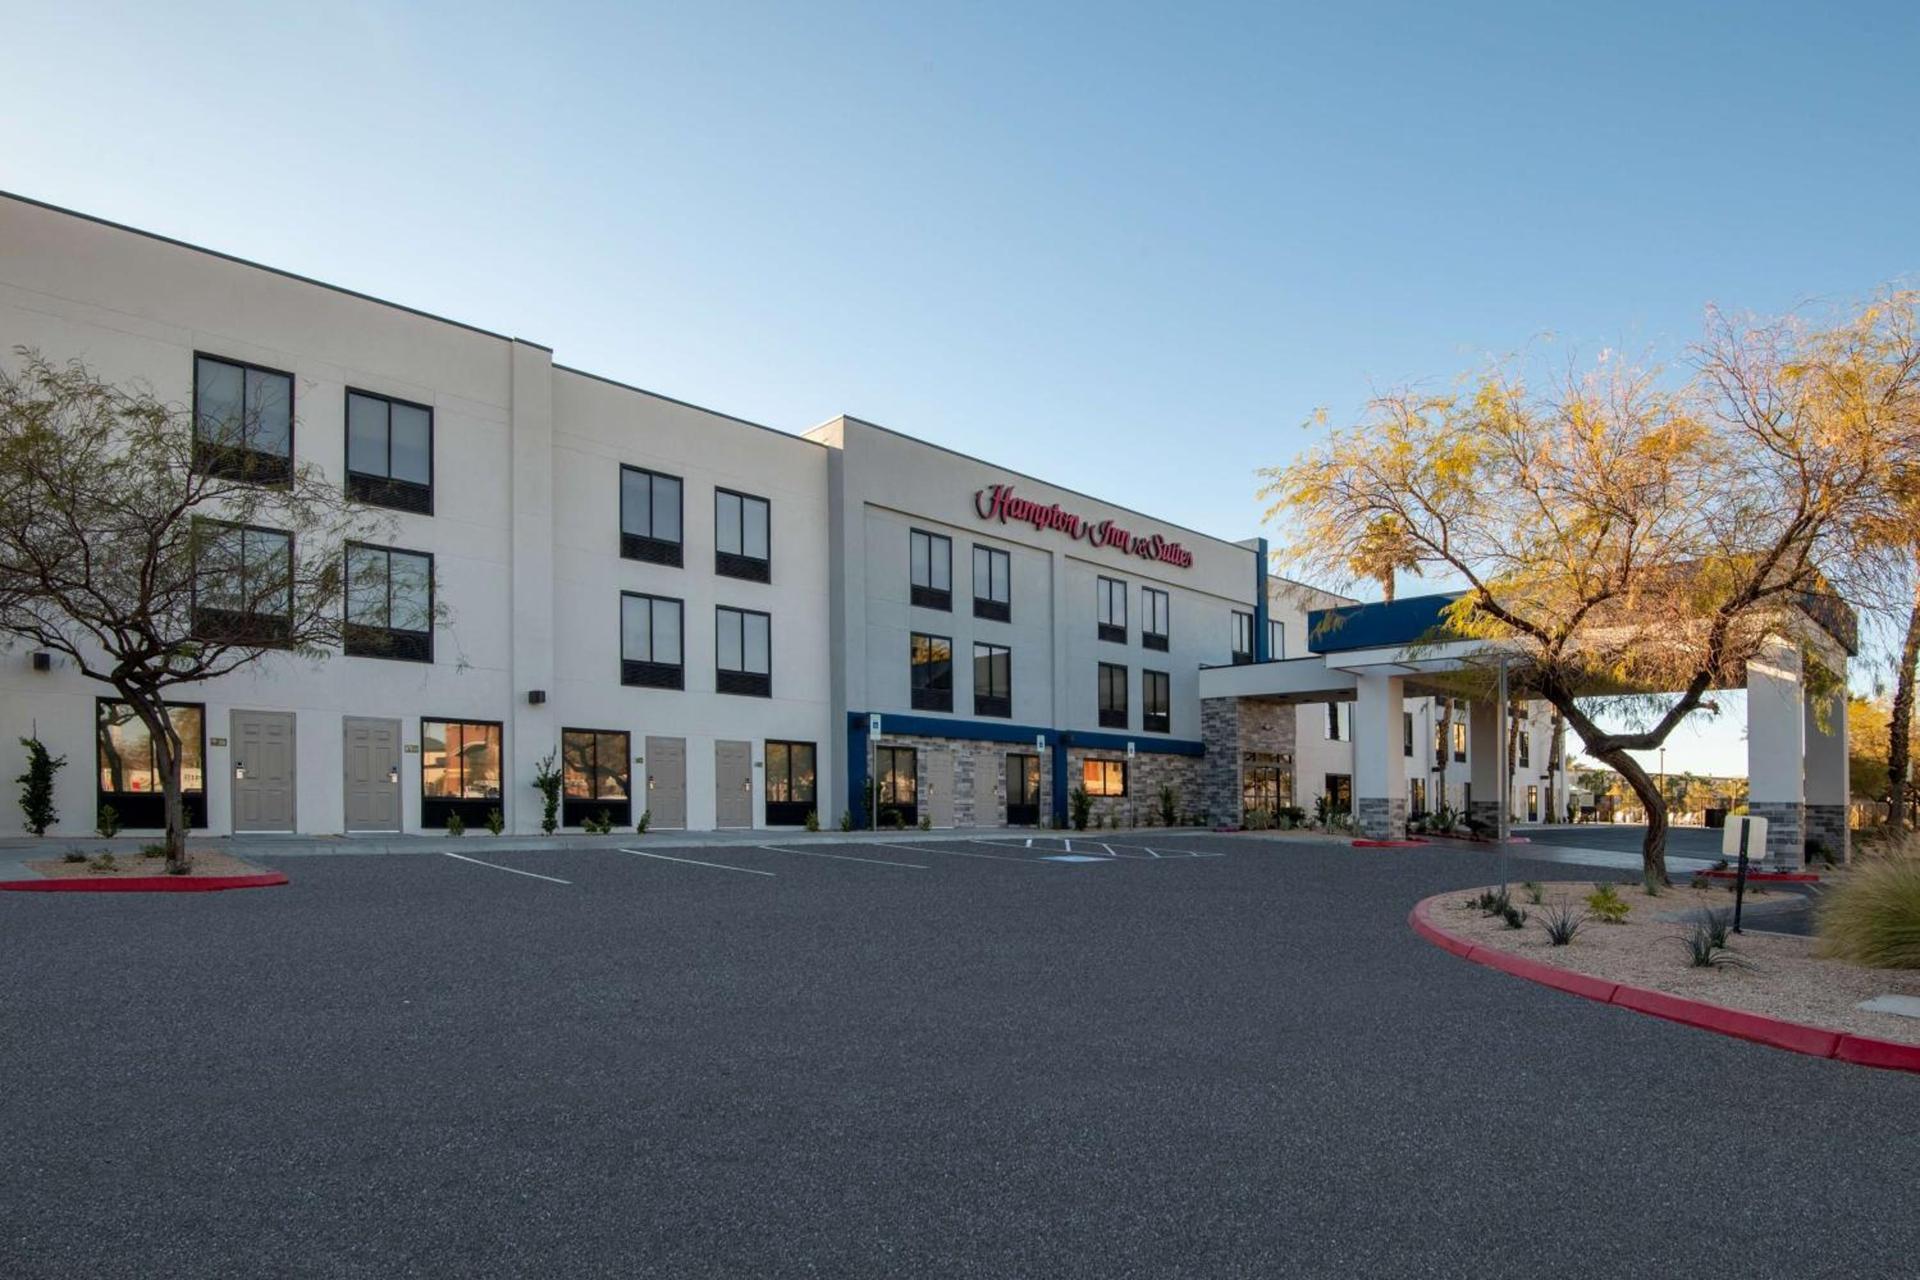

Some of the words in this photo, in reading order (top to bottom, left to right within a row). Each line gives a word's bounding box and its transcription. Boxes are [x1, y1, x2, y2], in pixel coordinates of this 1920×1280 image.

[975, 484, 1088, 540] Hampton
[1088, 520, 1138, 555] Inn
[1135, 537, 1149, 560] &
[1146, 534, 1192, 568] Suites
